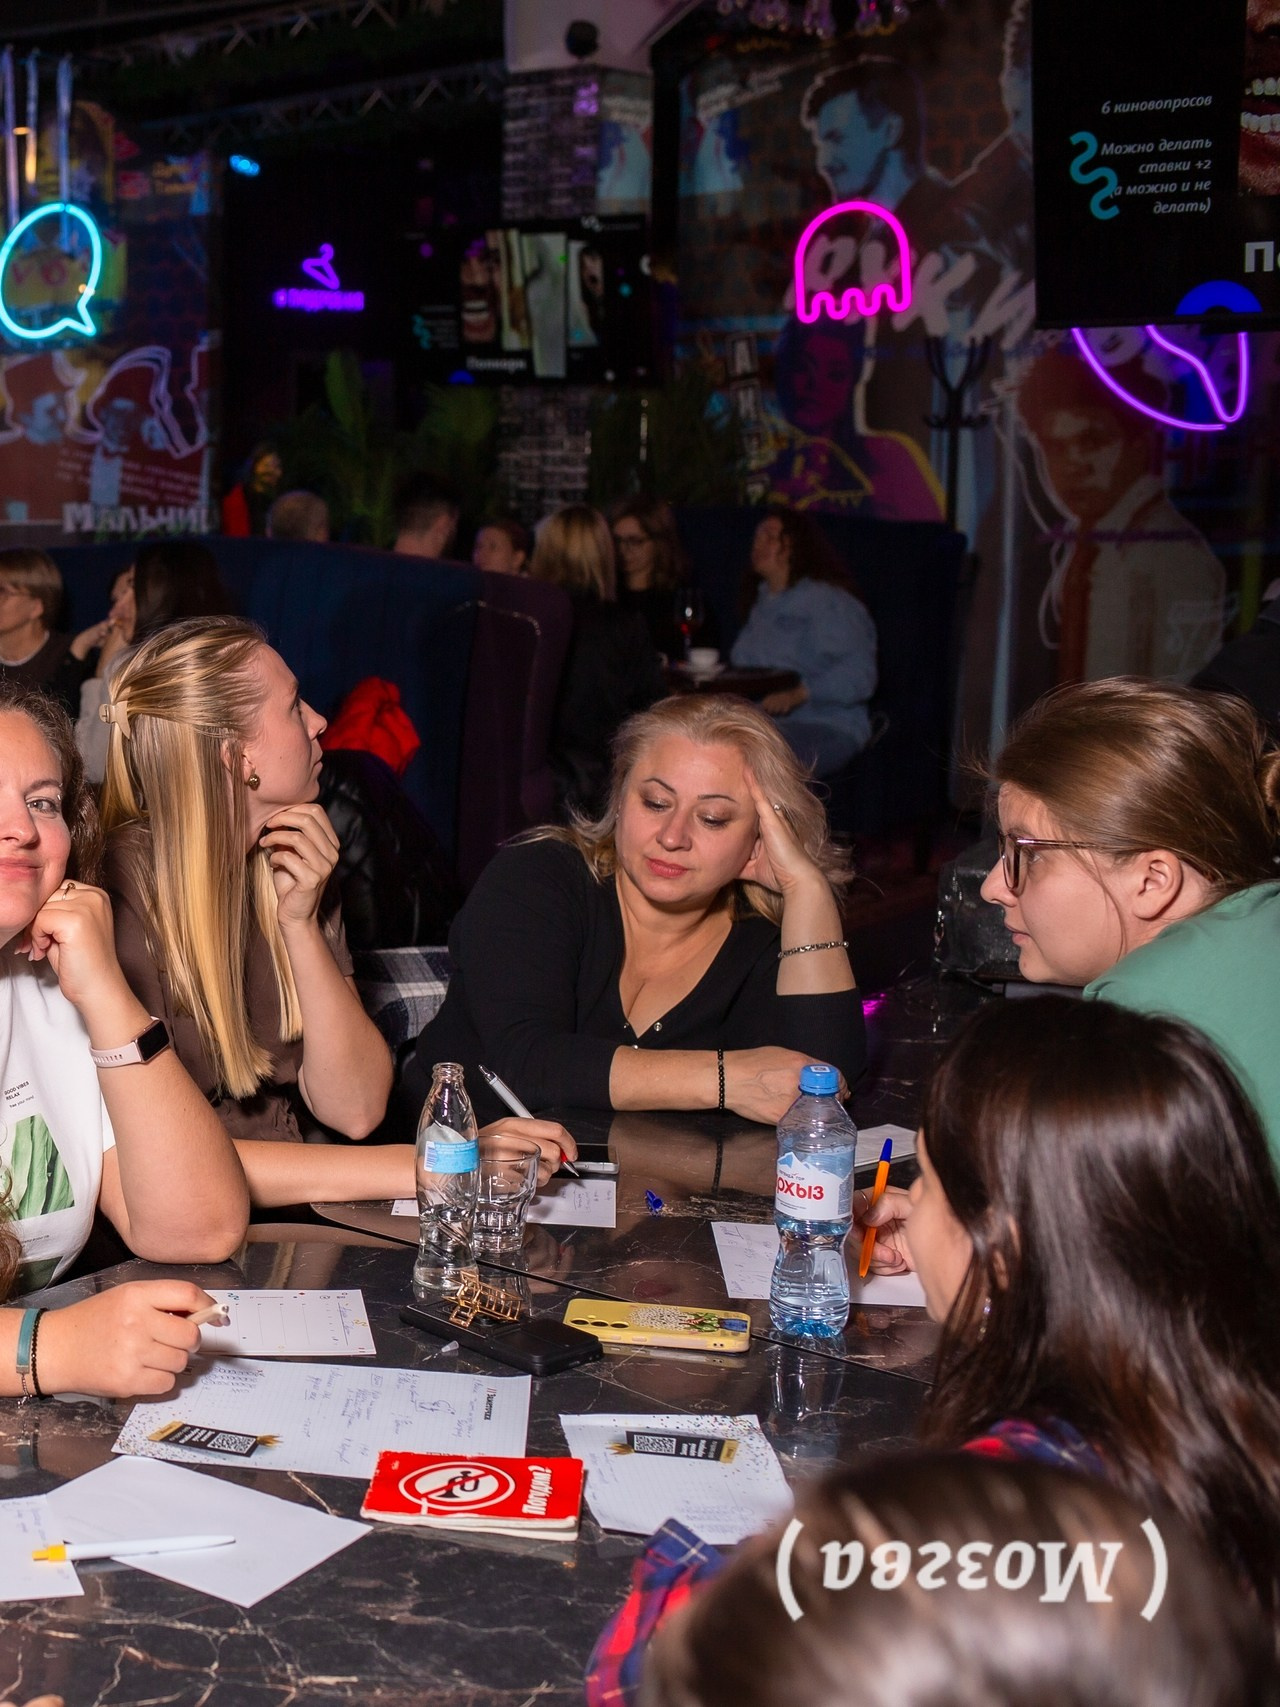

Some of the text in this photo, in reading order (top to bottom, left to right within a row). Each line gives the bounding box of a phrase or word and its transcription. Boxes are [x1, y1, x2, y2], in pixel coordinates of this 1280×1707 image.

[1101, 95, 1213, 115] 6 киновопросов
[1101, 137, 1213, 156] Можно делать
[1138, 159, 1212, 174] ставки +2
[1126, 181, 1177, 195] можно
[1180, 181, 1190, 193] и
[1193, 178, 1212, 191] не
[1153, 197, 1211, 214] делать)
[1245, 241, 1280, 273] П
